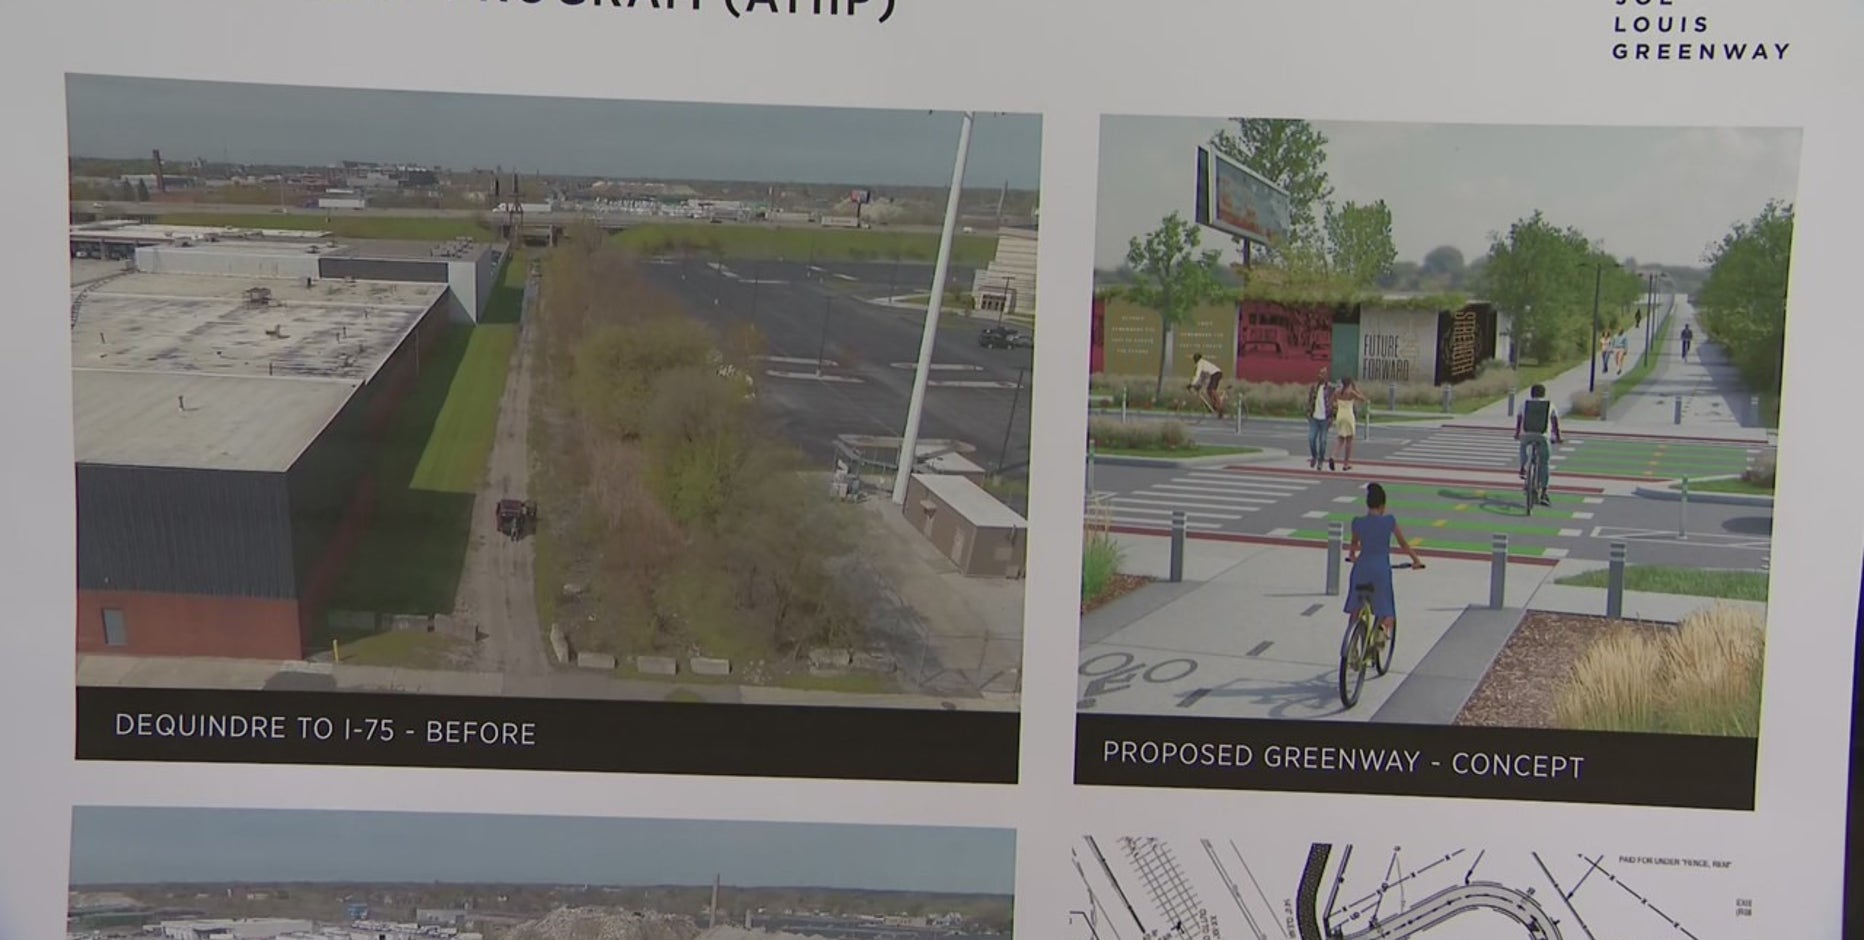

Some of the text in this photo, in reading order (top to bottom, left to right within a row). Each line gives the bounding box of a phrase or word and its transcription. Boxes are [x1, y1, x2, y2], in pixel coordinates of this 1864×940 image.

[1614, 16, 1707, 33] LOUIS
[1612, 43, 1790, 60] GREENWAY
[1363, 334, 1399, 358] FUTURE
[1362, 358, 1409, 381] FORWARD
[116, 713, 286, 738] DEQUINDRE
[298, 717, 333, 740] TO
[345, 718, 394, 741] I-75
[427, 720, 536, 746] BEFORE
[1103, 740, 1253, 766] PROPOSED
[1264, 745, 1420, 772] GREENWAY
[1452, 752, 1585, 779] CONCEPT
[1618, 855, 1636, 864] PAID
[1637, 856, 1653, 865] FOR
[1653, 857, 1680, 866] UNDER
